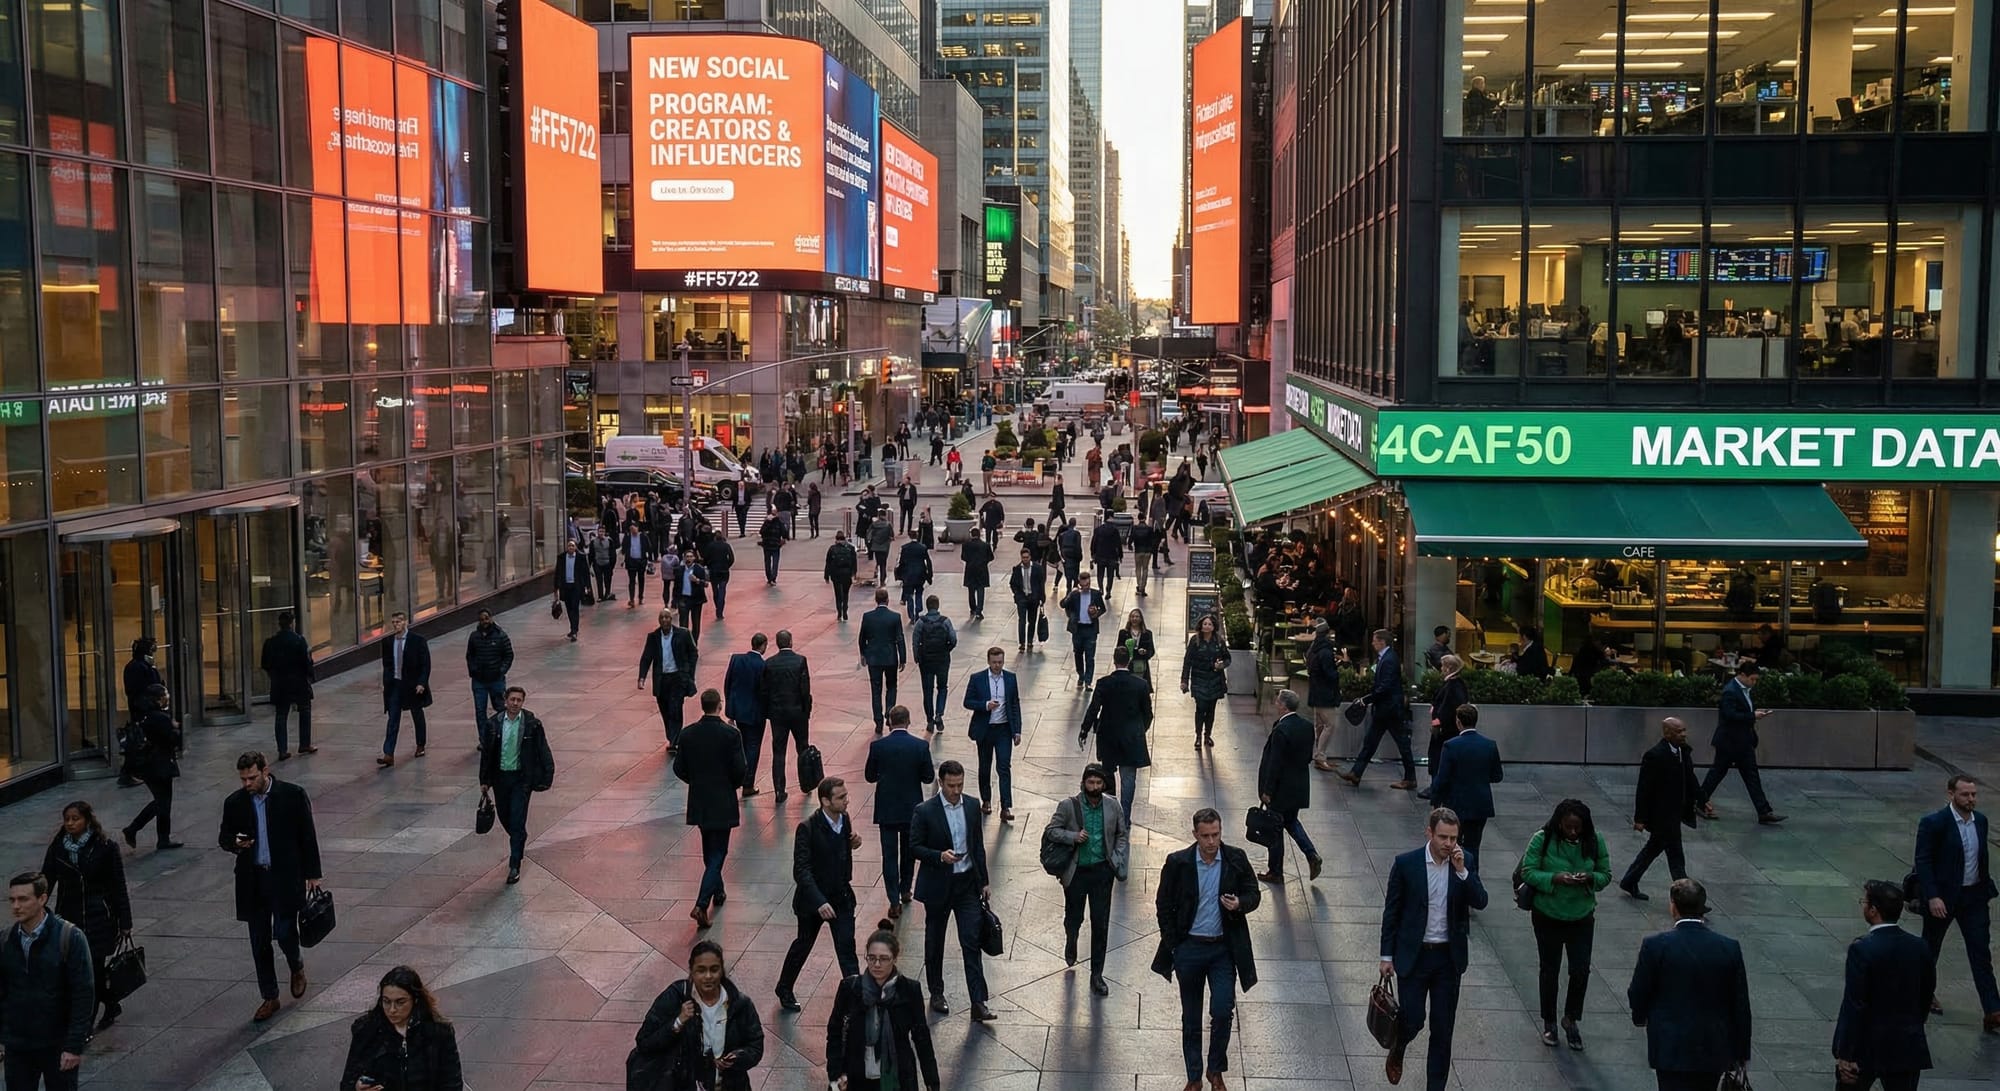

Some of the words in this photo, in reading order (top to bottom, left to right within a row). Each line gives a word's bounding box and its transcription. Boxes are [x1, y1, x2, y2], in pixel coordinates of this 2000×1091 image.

[649, 56, 700, 79] NEW
[707, 56, 790, 80] SOCIAL
[649, 92, 773, 116] PROGRAM:
[530, 104, 597, 161] #FF5722
[649, 118, 771, 141] CREATORS
[776, 119, 791, 142] &
[650, 143, 802, 168] INFLUENCERS
[684, 271, 760, 287] #FF5722
[1631, 426, 1856, 467] MARKET
[1871, 427, 2000, 468] DATA
[1622, 546, 1655, 558] CAFE
